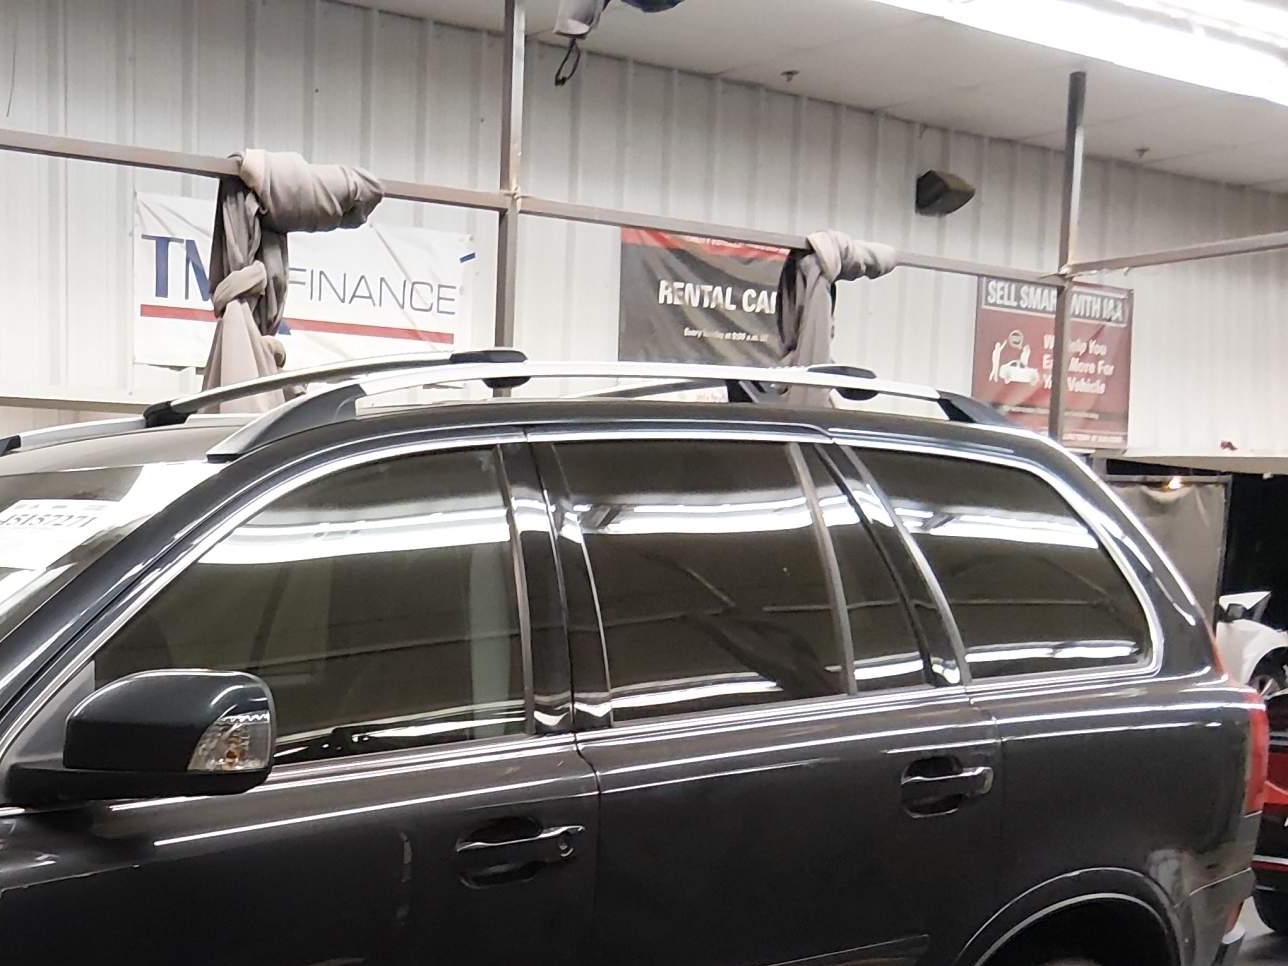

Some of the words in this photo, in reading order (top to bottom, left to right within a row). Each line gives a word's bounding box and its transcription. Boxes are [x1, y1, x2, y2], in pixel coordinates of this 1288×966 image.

[288, 267, 457, 316] FINANCE
[658, 279, 736, 311] RENTAL
[988, 280, 1018, 308] SELL
[1020, 285, 1057, 312] SMAR
[1066, 376, 1106, 395] Vehicle
